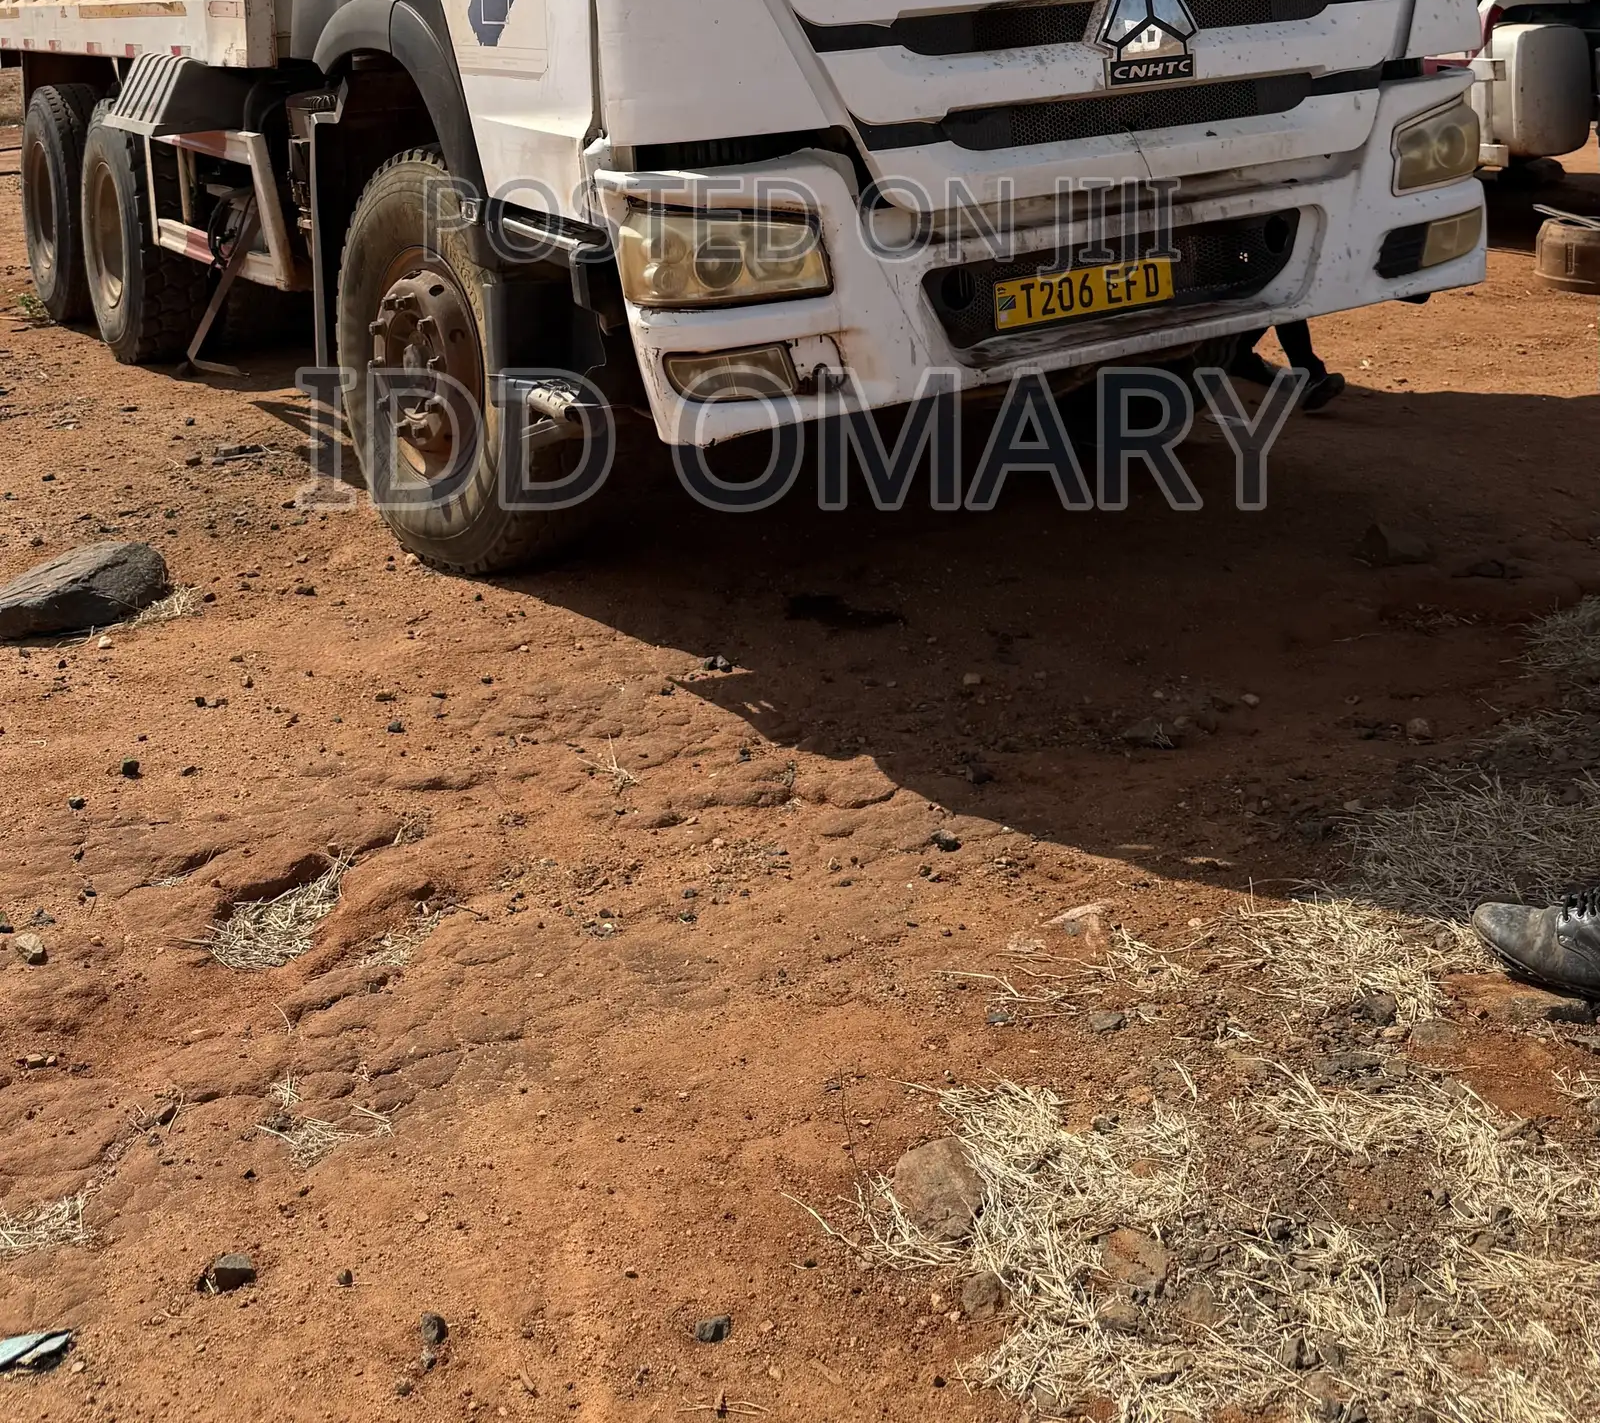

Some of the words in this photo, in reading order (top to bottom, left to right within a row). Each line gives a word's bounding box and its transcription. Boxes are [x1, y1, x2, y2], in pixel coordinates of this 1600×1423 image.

[1113, 59, 1192, 79] CNHTC
[1020, 273, 1094, 319] T206
[1105, 263, 1160, 305] EFD
